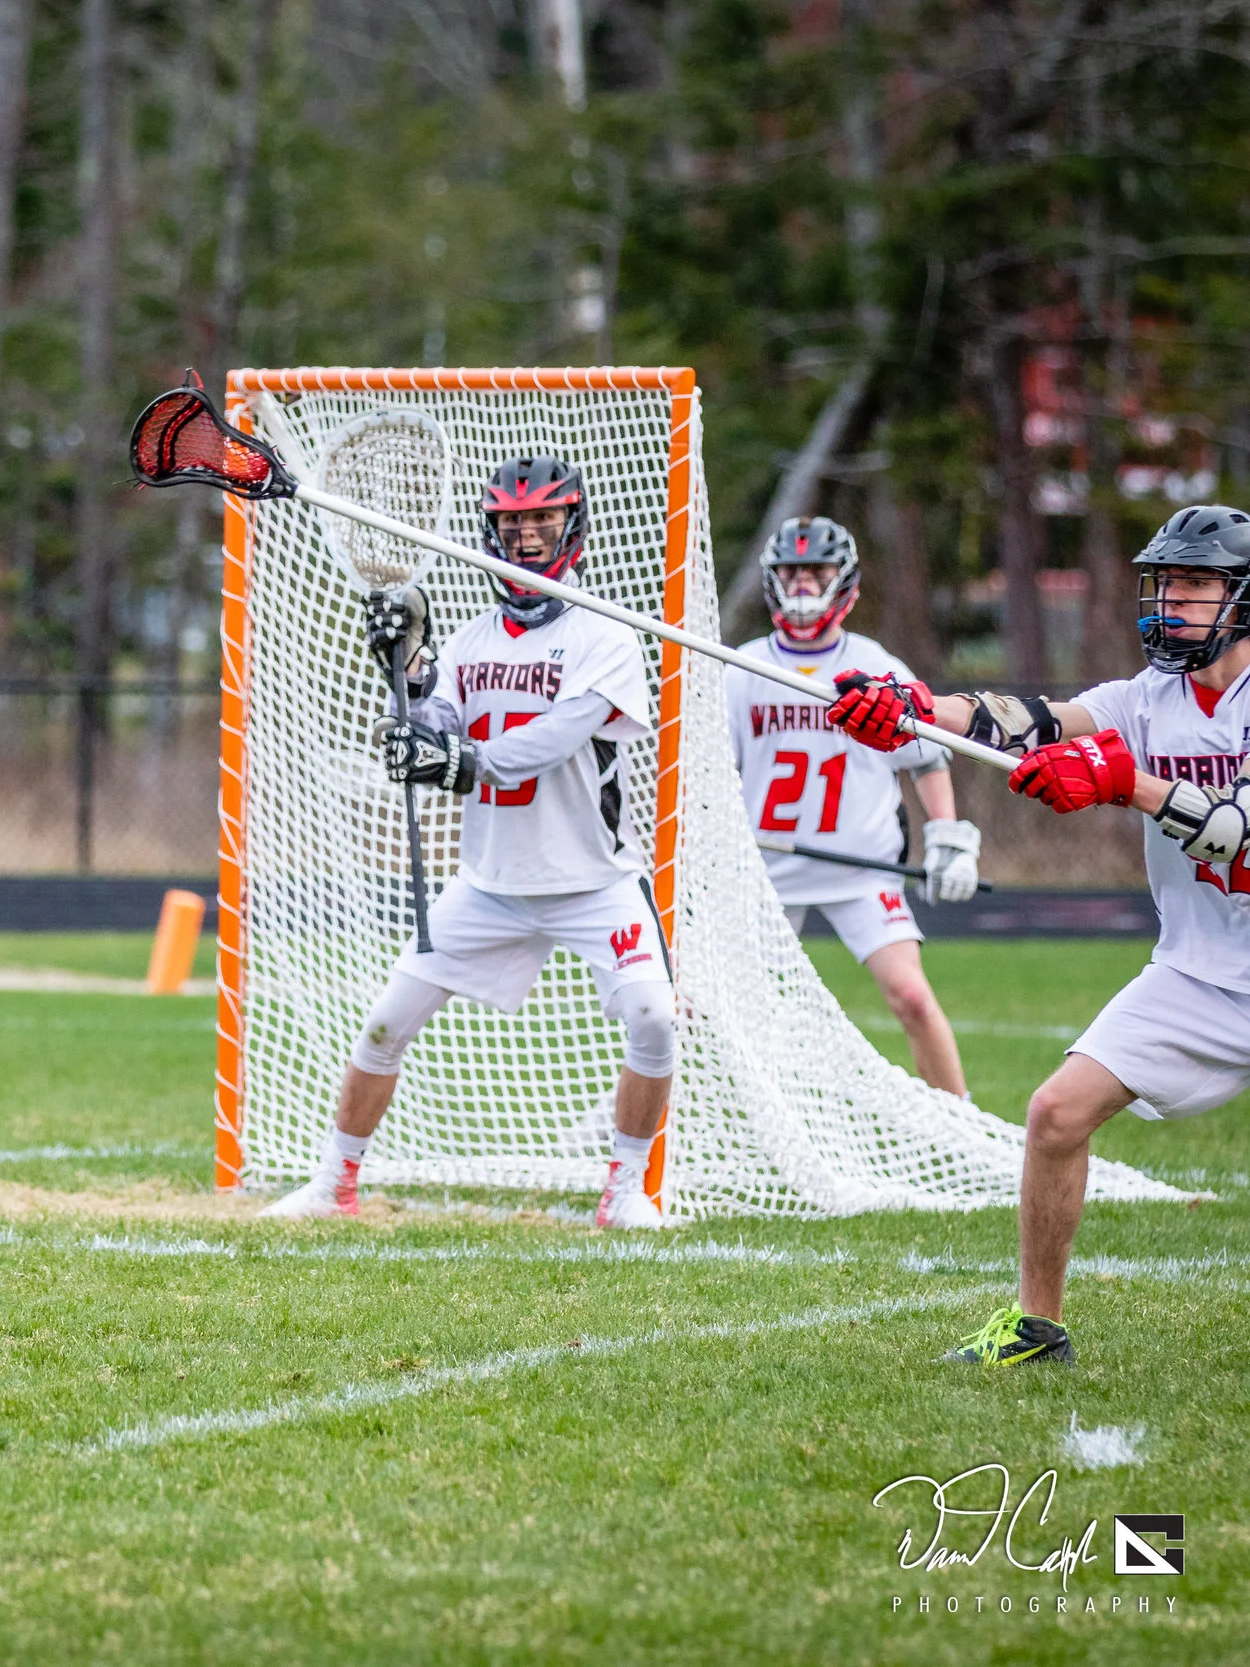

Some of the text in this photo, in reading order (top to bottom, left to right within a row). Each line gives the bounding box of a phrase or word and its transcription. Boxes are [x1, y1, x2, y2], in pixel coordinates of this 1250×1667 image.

[751, 705, 848, 738] WARRIO
[1080, 738, 1107, 767] STX
[759, 751, 848, 833] 21
[610, 923, 642, 959] W
